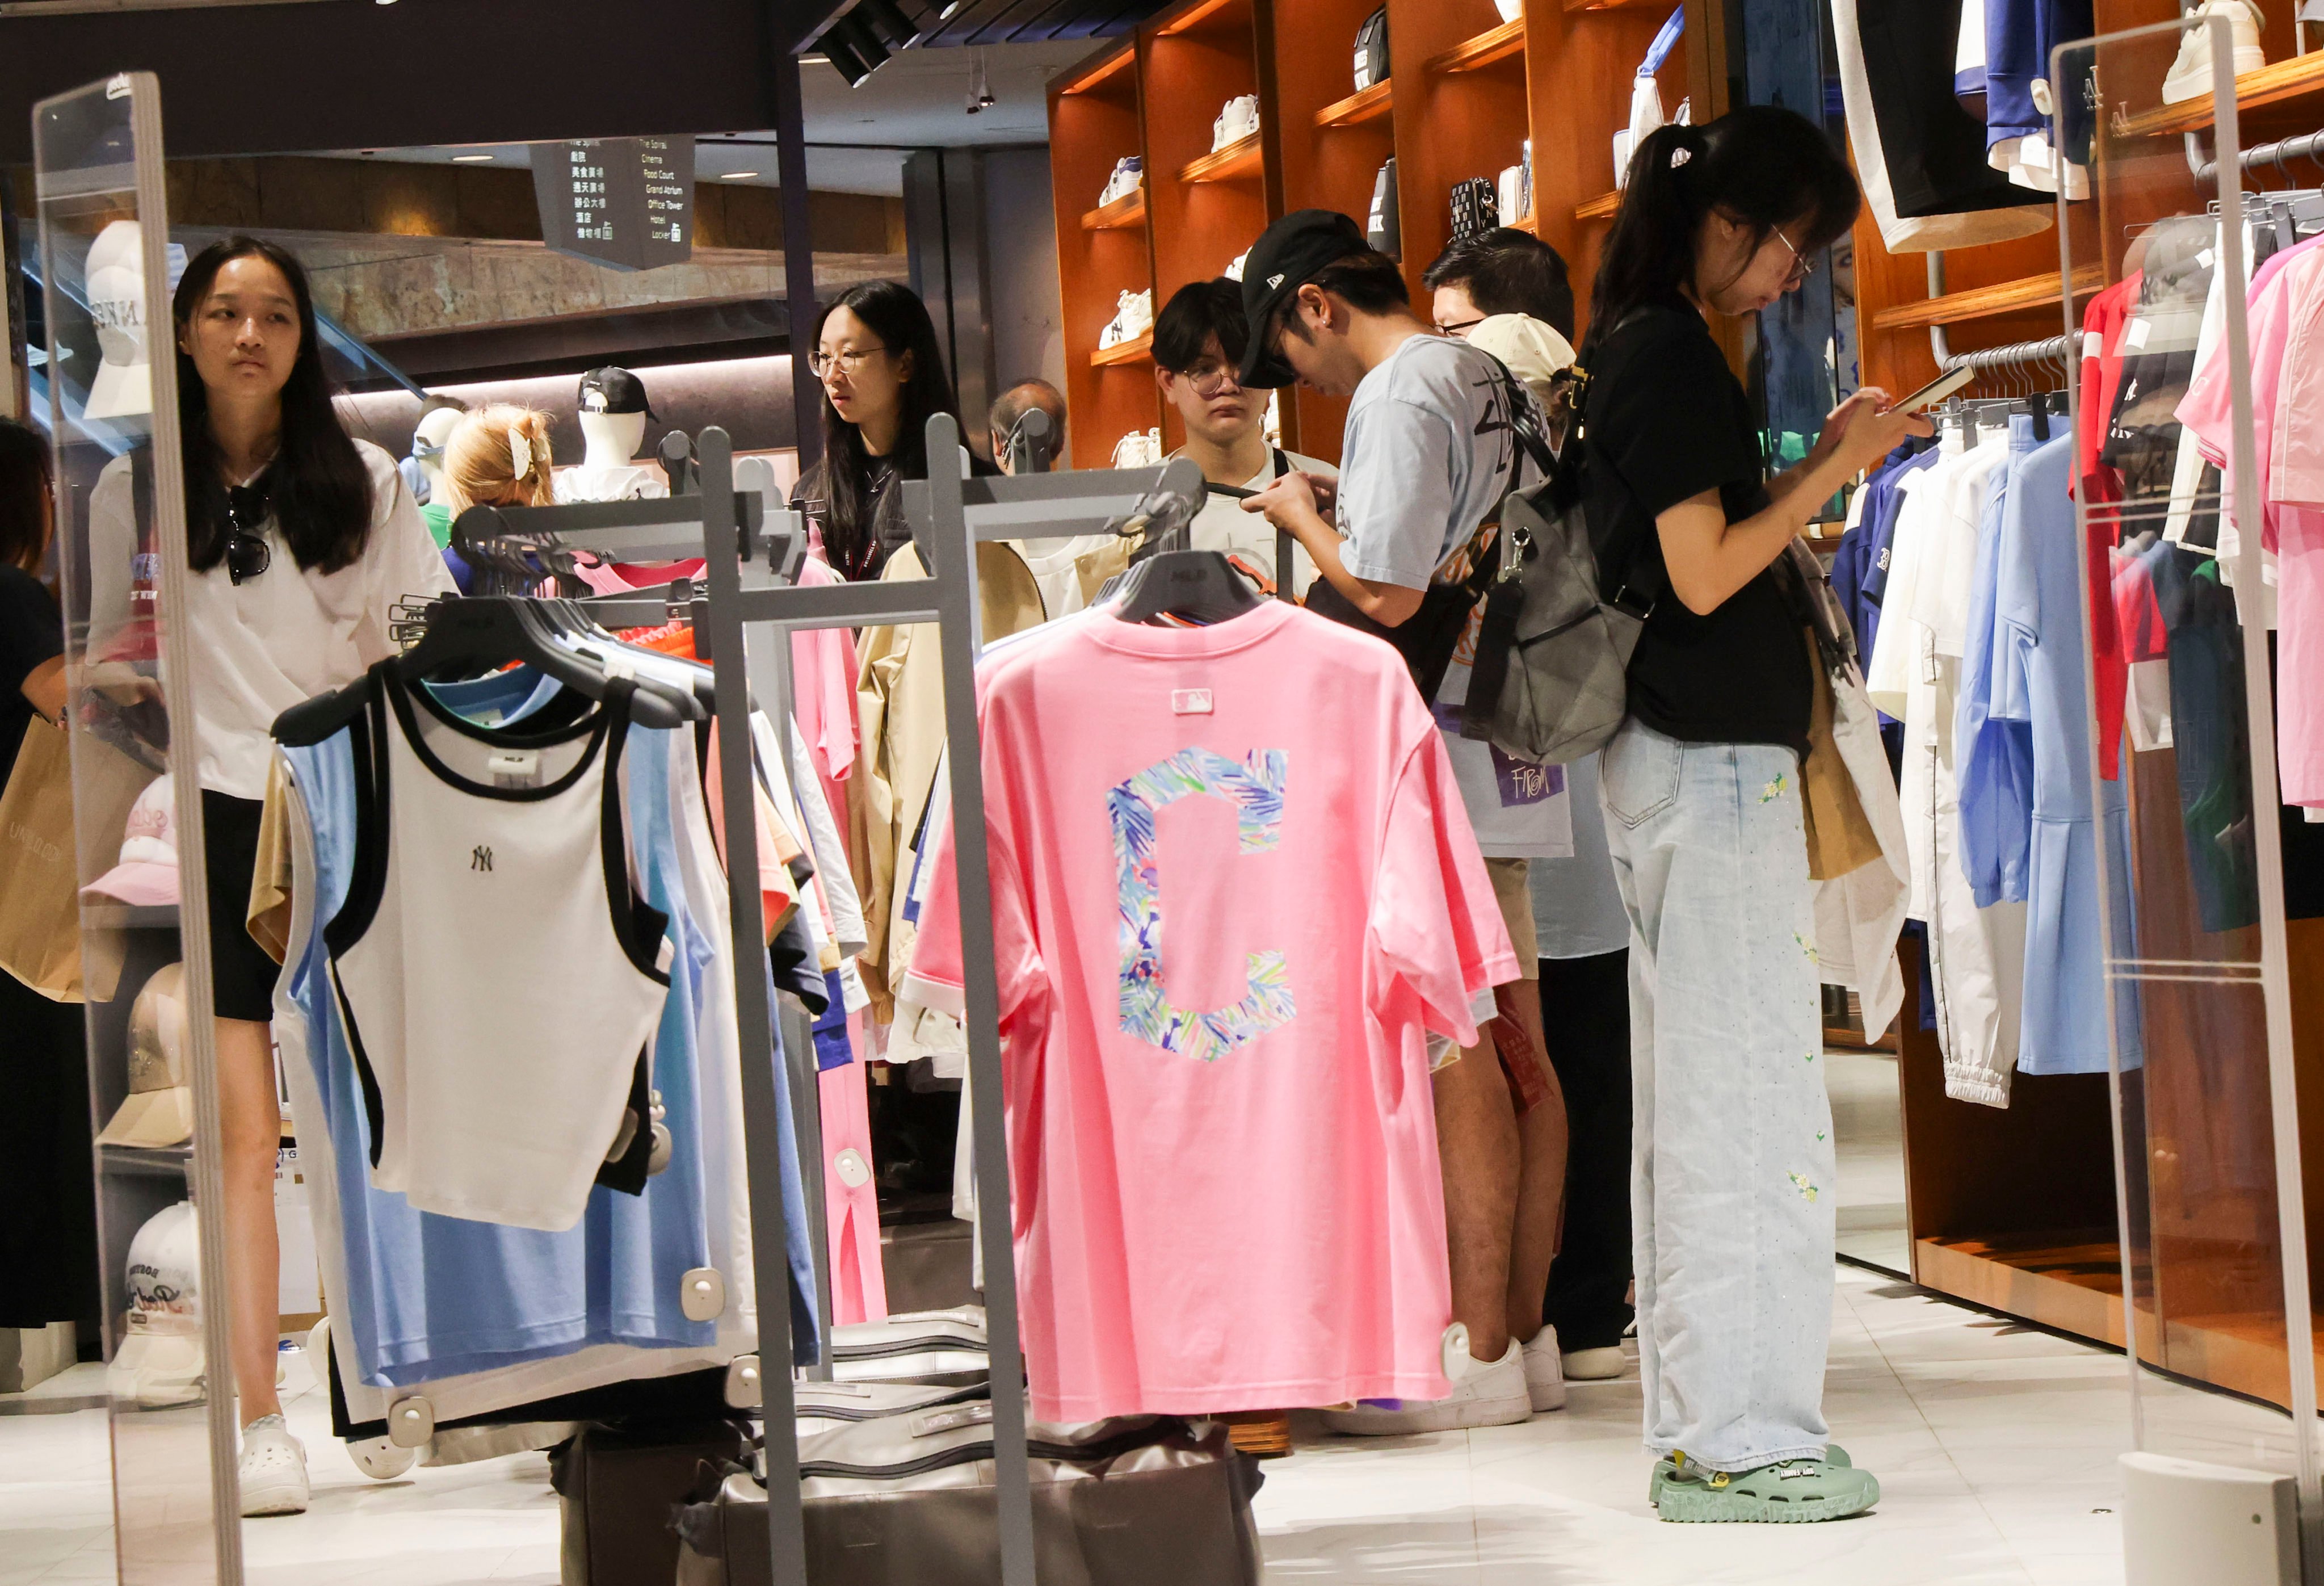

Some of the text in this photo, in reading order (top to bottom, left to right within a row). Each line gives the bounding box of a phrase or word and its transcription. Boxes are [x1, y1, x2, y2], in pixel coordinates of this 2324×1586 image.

[642, 154, 662, 164] Cinema
[572, 166, 604, 178] 美食廣場
[644, 169, 674, 180] Food Court
[646, 184, 683, 195] Grand Atrium
[648, 199, 683, 210] Office Tower
[575, 212, 591, 223] 酒店
[650, 216, 666, 224] Hotel
[652, 230, 670, 239] Locker
[1877, 547, 1890, 572] B
